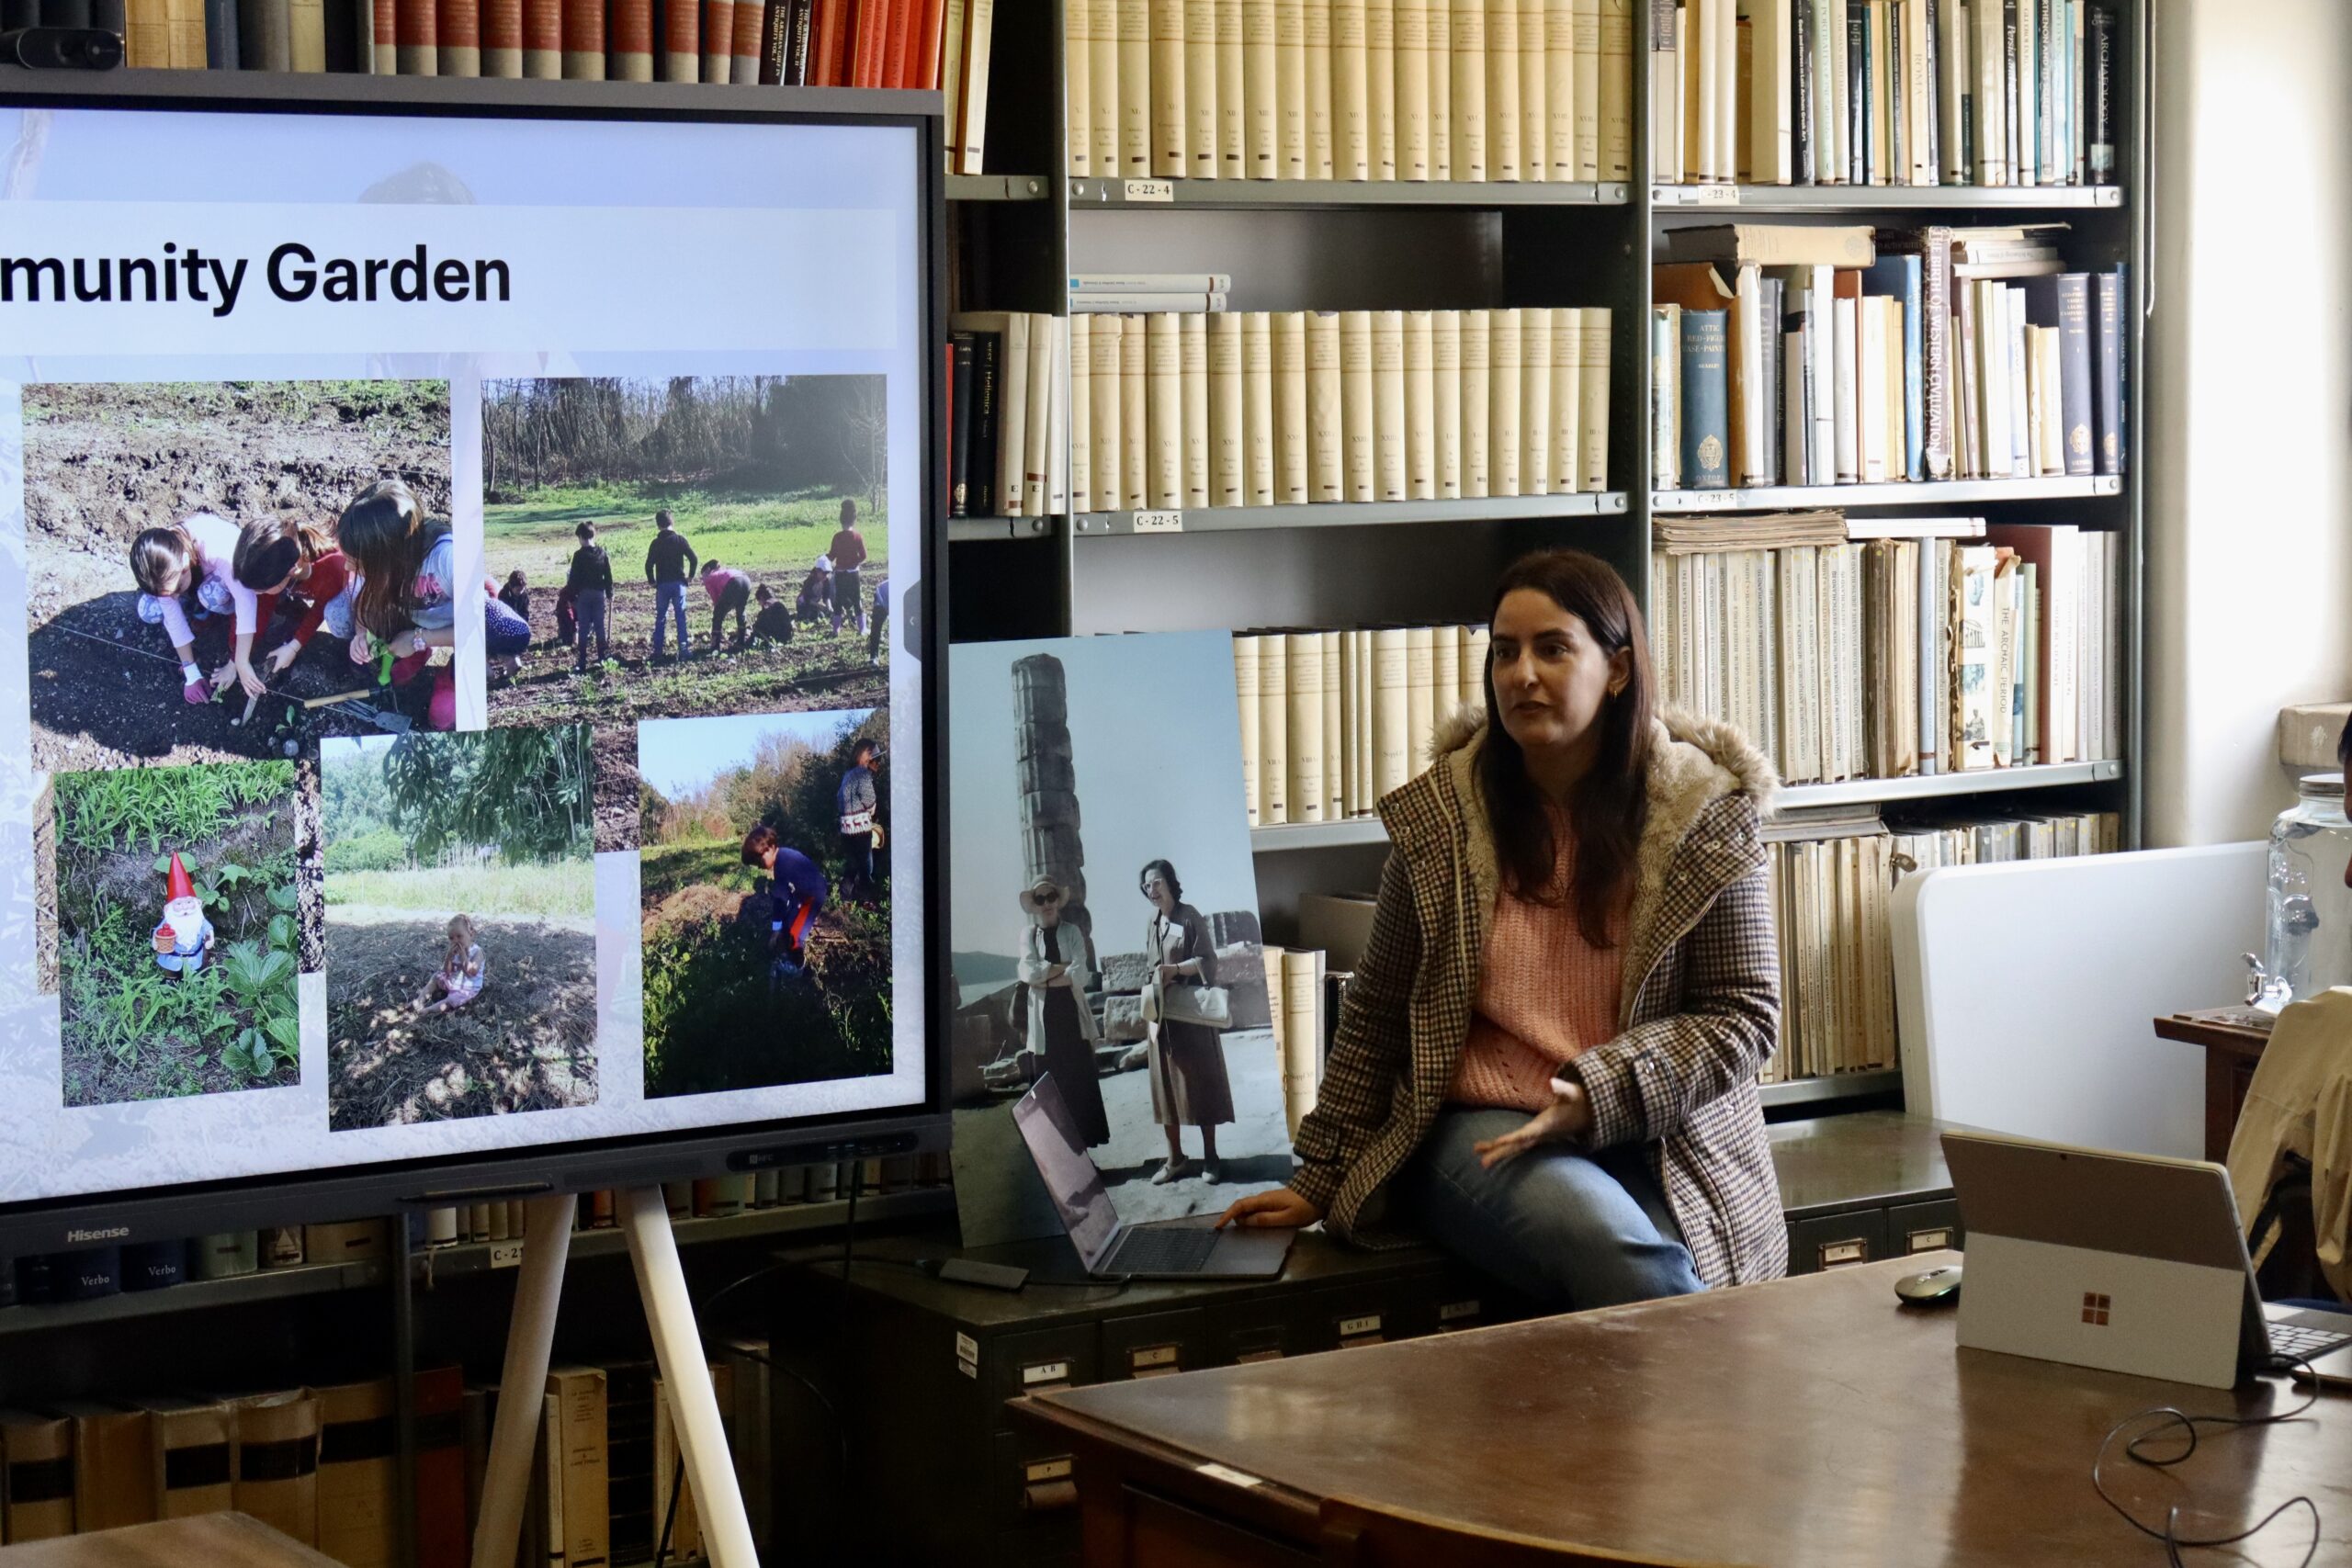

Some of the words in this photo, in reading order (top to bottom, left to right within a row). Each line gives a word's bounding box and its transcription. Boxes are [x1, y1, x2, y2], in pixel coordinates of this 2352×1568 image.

[1820, 6, 1828, 66] PORTRAITS
[2006, 25, 2016, 56] Persia
[1913, 53, 1923, 96] ROMA
[2100, 33, 2109, 125] ARCHAEOLOGY
[0, 243, 248, 317] munity
[266, 242, 511, 302] Garden
[1930, 255, 1942, 291] BIRTH
[1930, 295, 1942, 310] OF
[1687, 334, 1725, 344] RED-FIGU
[1700, 323, 1720, 333] ATTIC
[1930, 314, 1942, 370] WESTERN
[983, 371, 992, 414] Hellenica
[1930, 373, 1942, 452] CIVILIZATION
[2002, 607, 2010, 625] THE
[67, 1227, 130, 1243] Hisense
[81, 1274, 110, 1287] Verbo
[148, 1264, 176, 1277] Verbo
